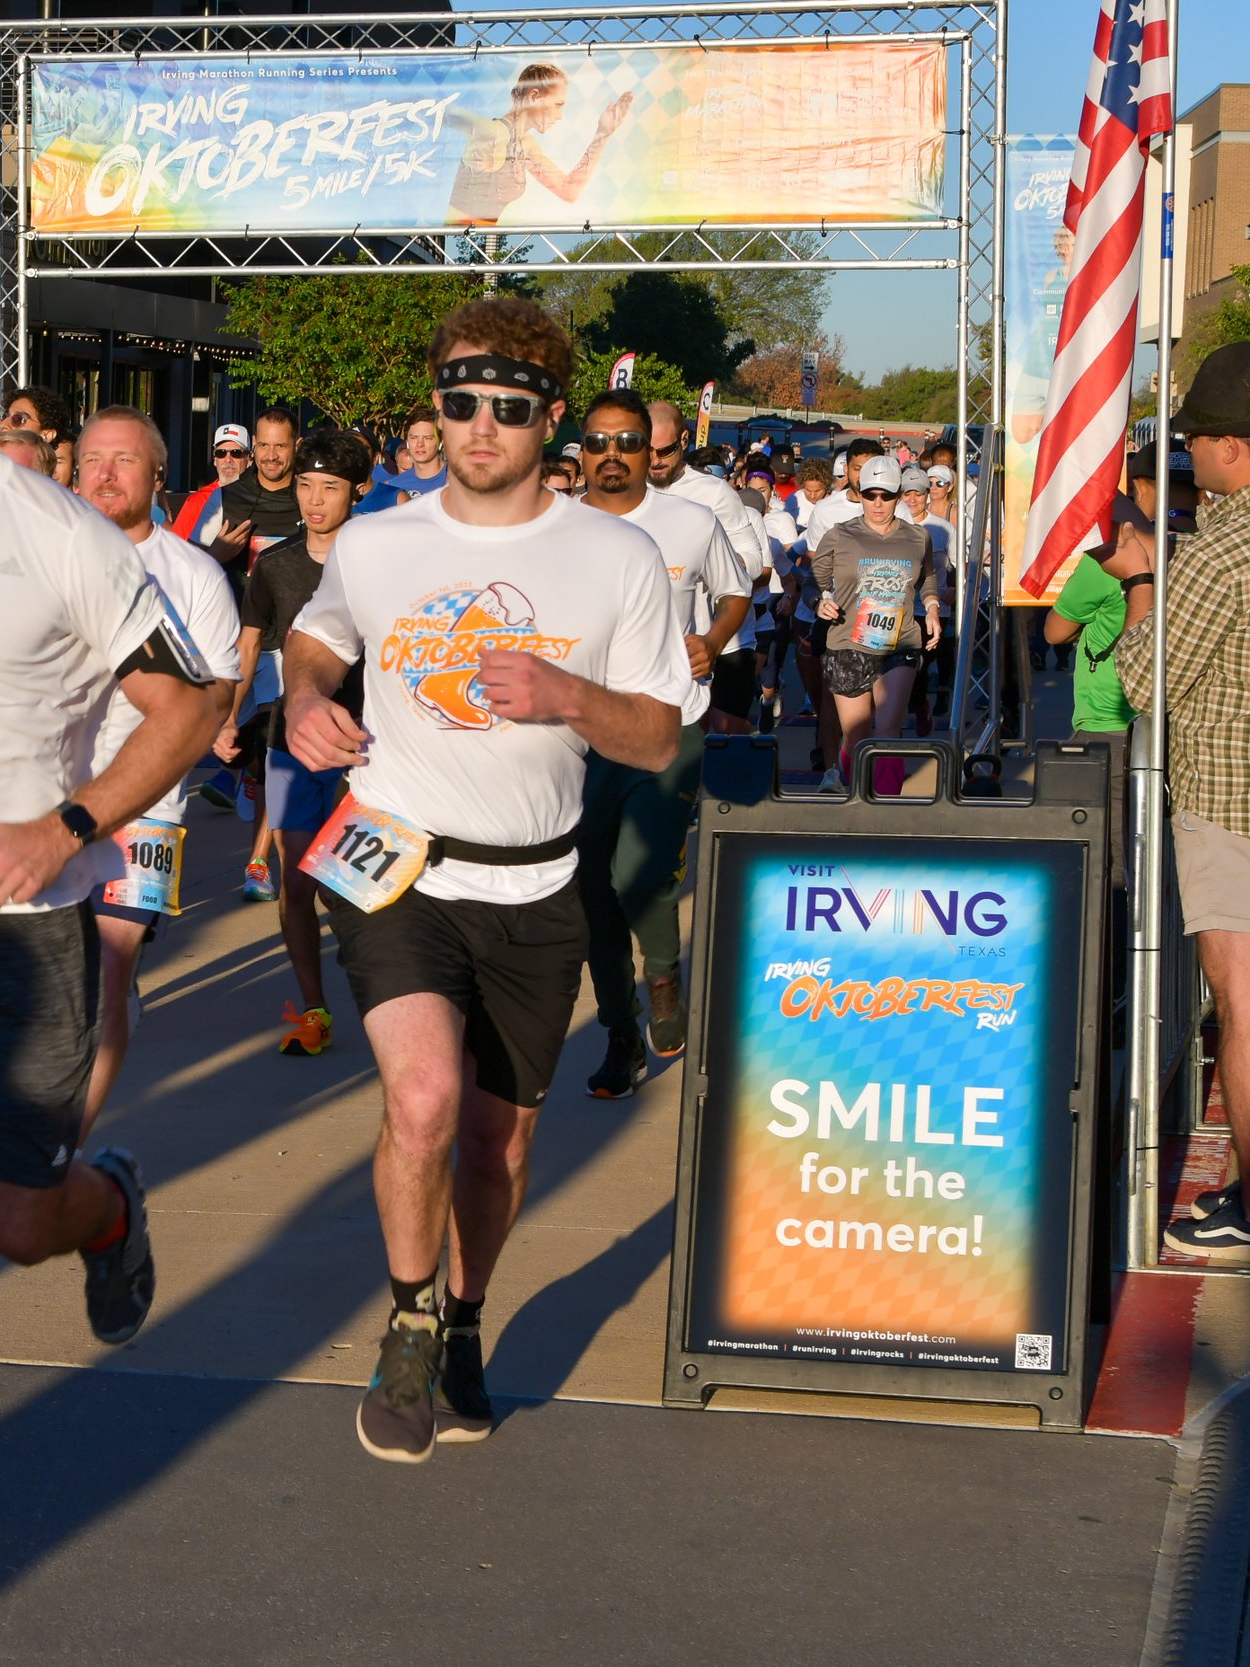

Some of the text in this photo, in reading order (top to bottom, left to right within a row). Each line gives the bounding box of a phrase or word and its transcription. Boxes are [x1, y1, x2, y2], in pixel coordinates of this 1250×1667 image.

[162, 66, 398, 80] Irving Marathon Running Series Presents
[124, 84, 251, 140] IRVING
[85, 92, 461, 216] OKTOBERFEST
[1029, 168, 1071, 188] IRVIN
[278, 175, 312, 210] 5
[858, 558, 912, 568] #RUNIRVING
[855, 577, 913, 594] FROST
[393, 616, 452, 633] IRVING
[866, 613, 896, 632] 1049
[128, 842, 173, 875] 1089
[331, 823, 401, 883] 1121
[787, 864, 835, 877] VISIT
[141, 894, 158, 904] FOOD
[785, 885, 1008, 938] IRVING
[958, 945, 1007, 958] TEXAS
[764, 957, 832, 982] IRVING
[779, 975, 1025, 1022] OKTOBERFEST
[976, 1009, 1017, 1032] RUN
[766, 1078, 1005, 1148] SMILE
[799, 1151, 966, 1200] for the
[776, 1214, 984, 1257] camera!
[796, 1327, 956, 1345] www.irvingoktoberfest.com
[707, 1339, 999, 1364] #irvingmarathon #runirving #irvingrocks #irvingoktoberfest
